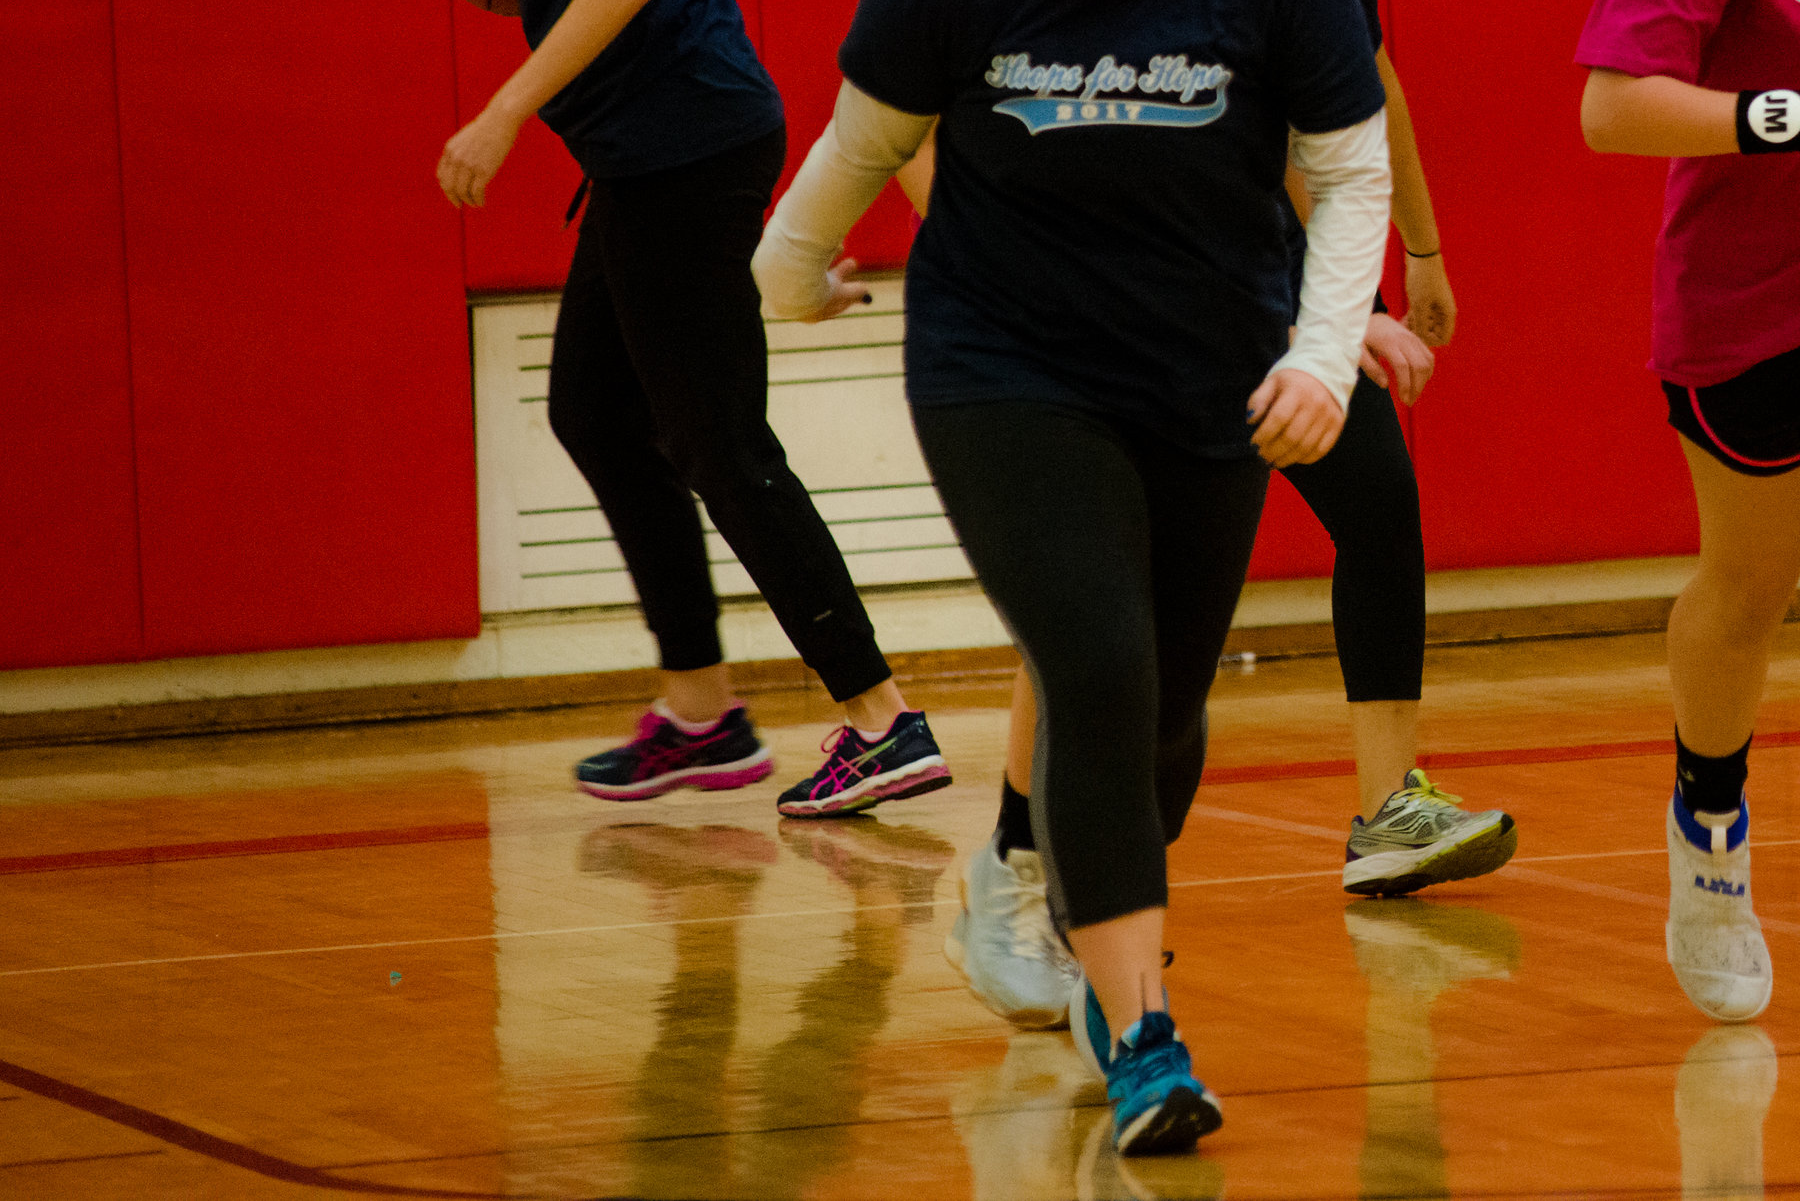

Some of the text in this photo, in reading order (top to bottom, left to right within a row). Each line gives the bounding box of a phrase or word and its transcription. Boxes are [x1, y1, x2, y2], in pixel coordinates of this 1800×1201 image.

[985, 52, 1234, 103] Hoops for Hope
[1056, 103, 1143, 121] 2017
[1765, 95, 1787, 133] JM
